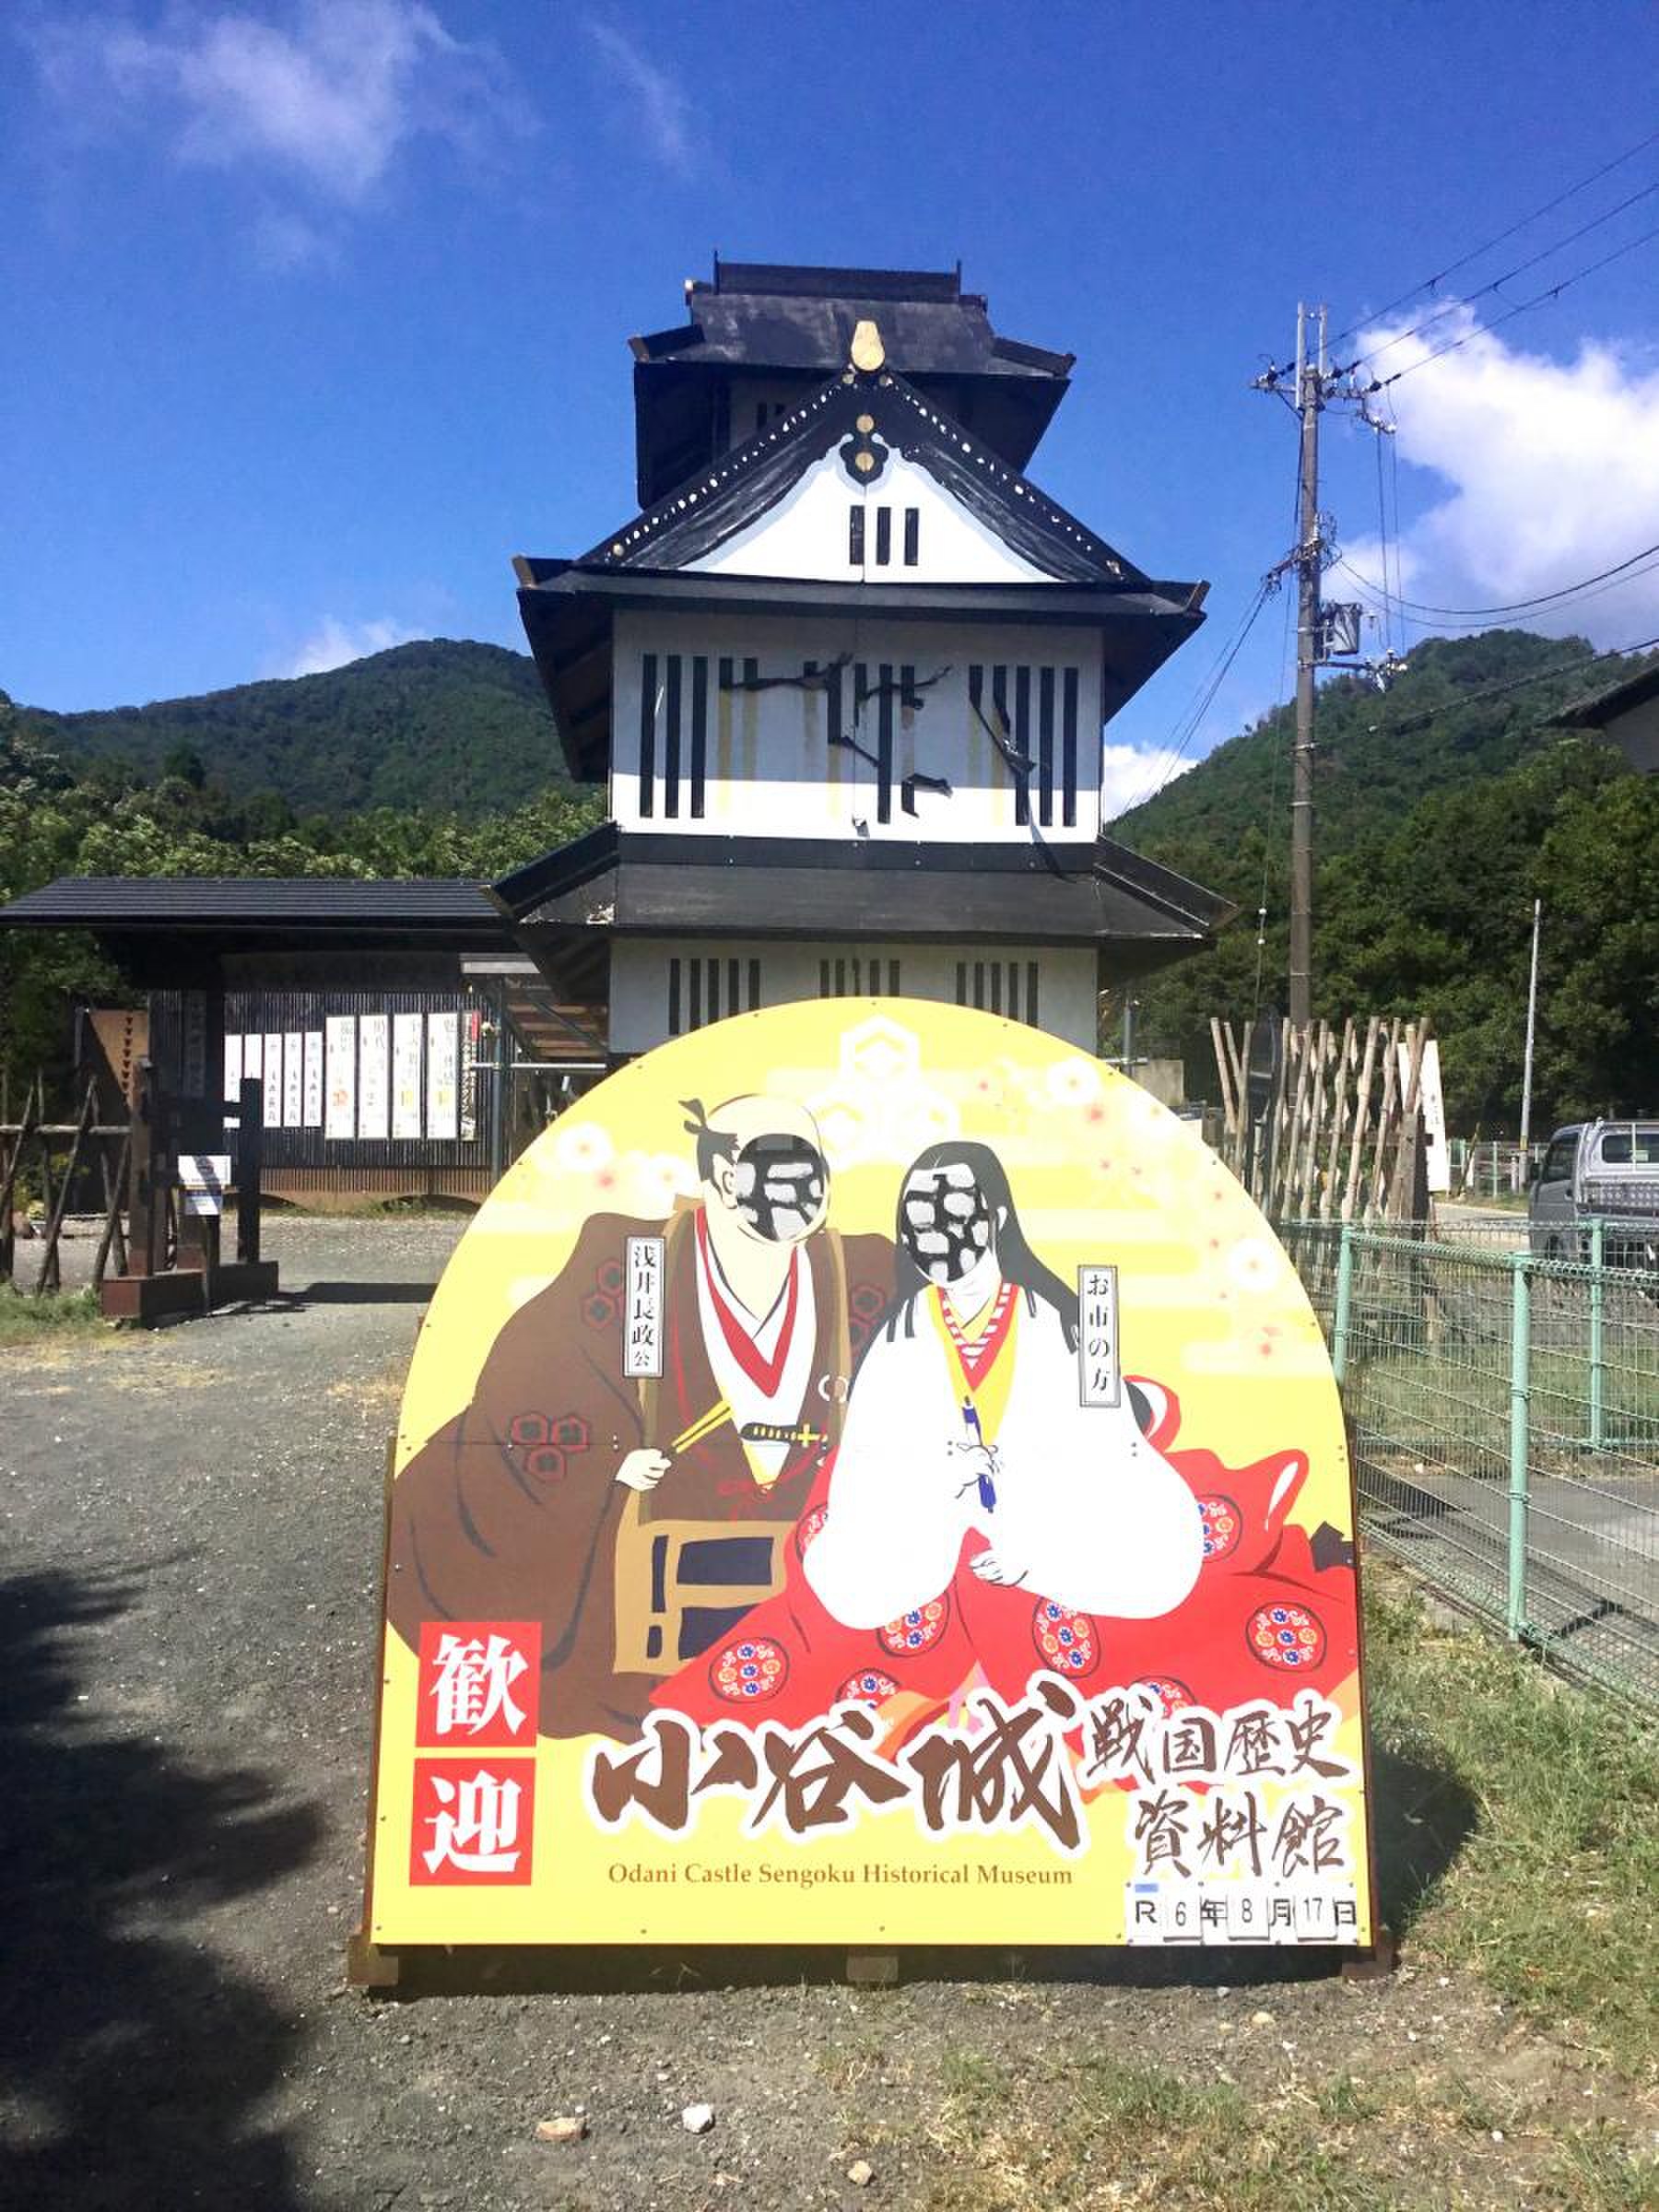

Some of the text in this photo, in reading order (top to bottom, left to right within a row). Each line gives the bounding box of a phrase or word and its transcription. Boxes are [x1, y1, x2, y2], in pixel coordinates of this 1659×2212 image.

[631, 1244, 657, 1368] 浅井長政公
[1087, 1268, 1112, 1392] お市の方
[591, 1679, 1081, 1851] 小谷城
[608, 1862, 1073, 1888] Odani Castle Sengoku Historical Museum
[1135, 1788, 1345, 1880] 資料館
